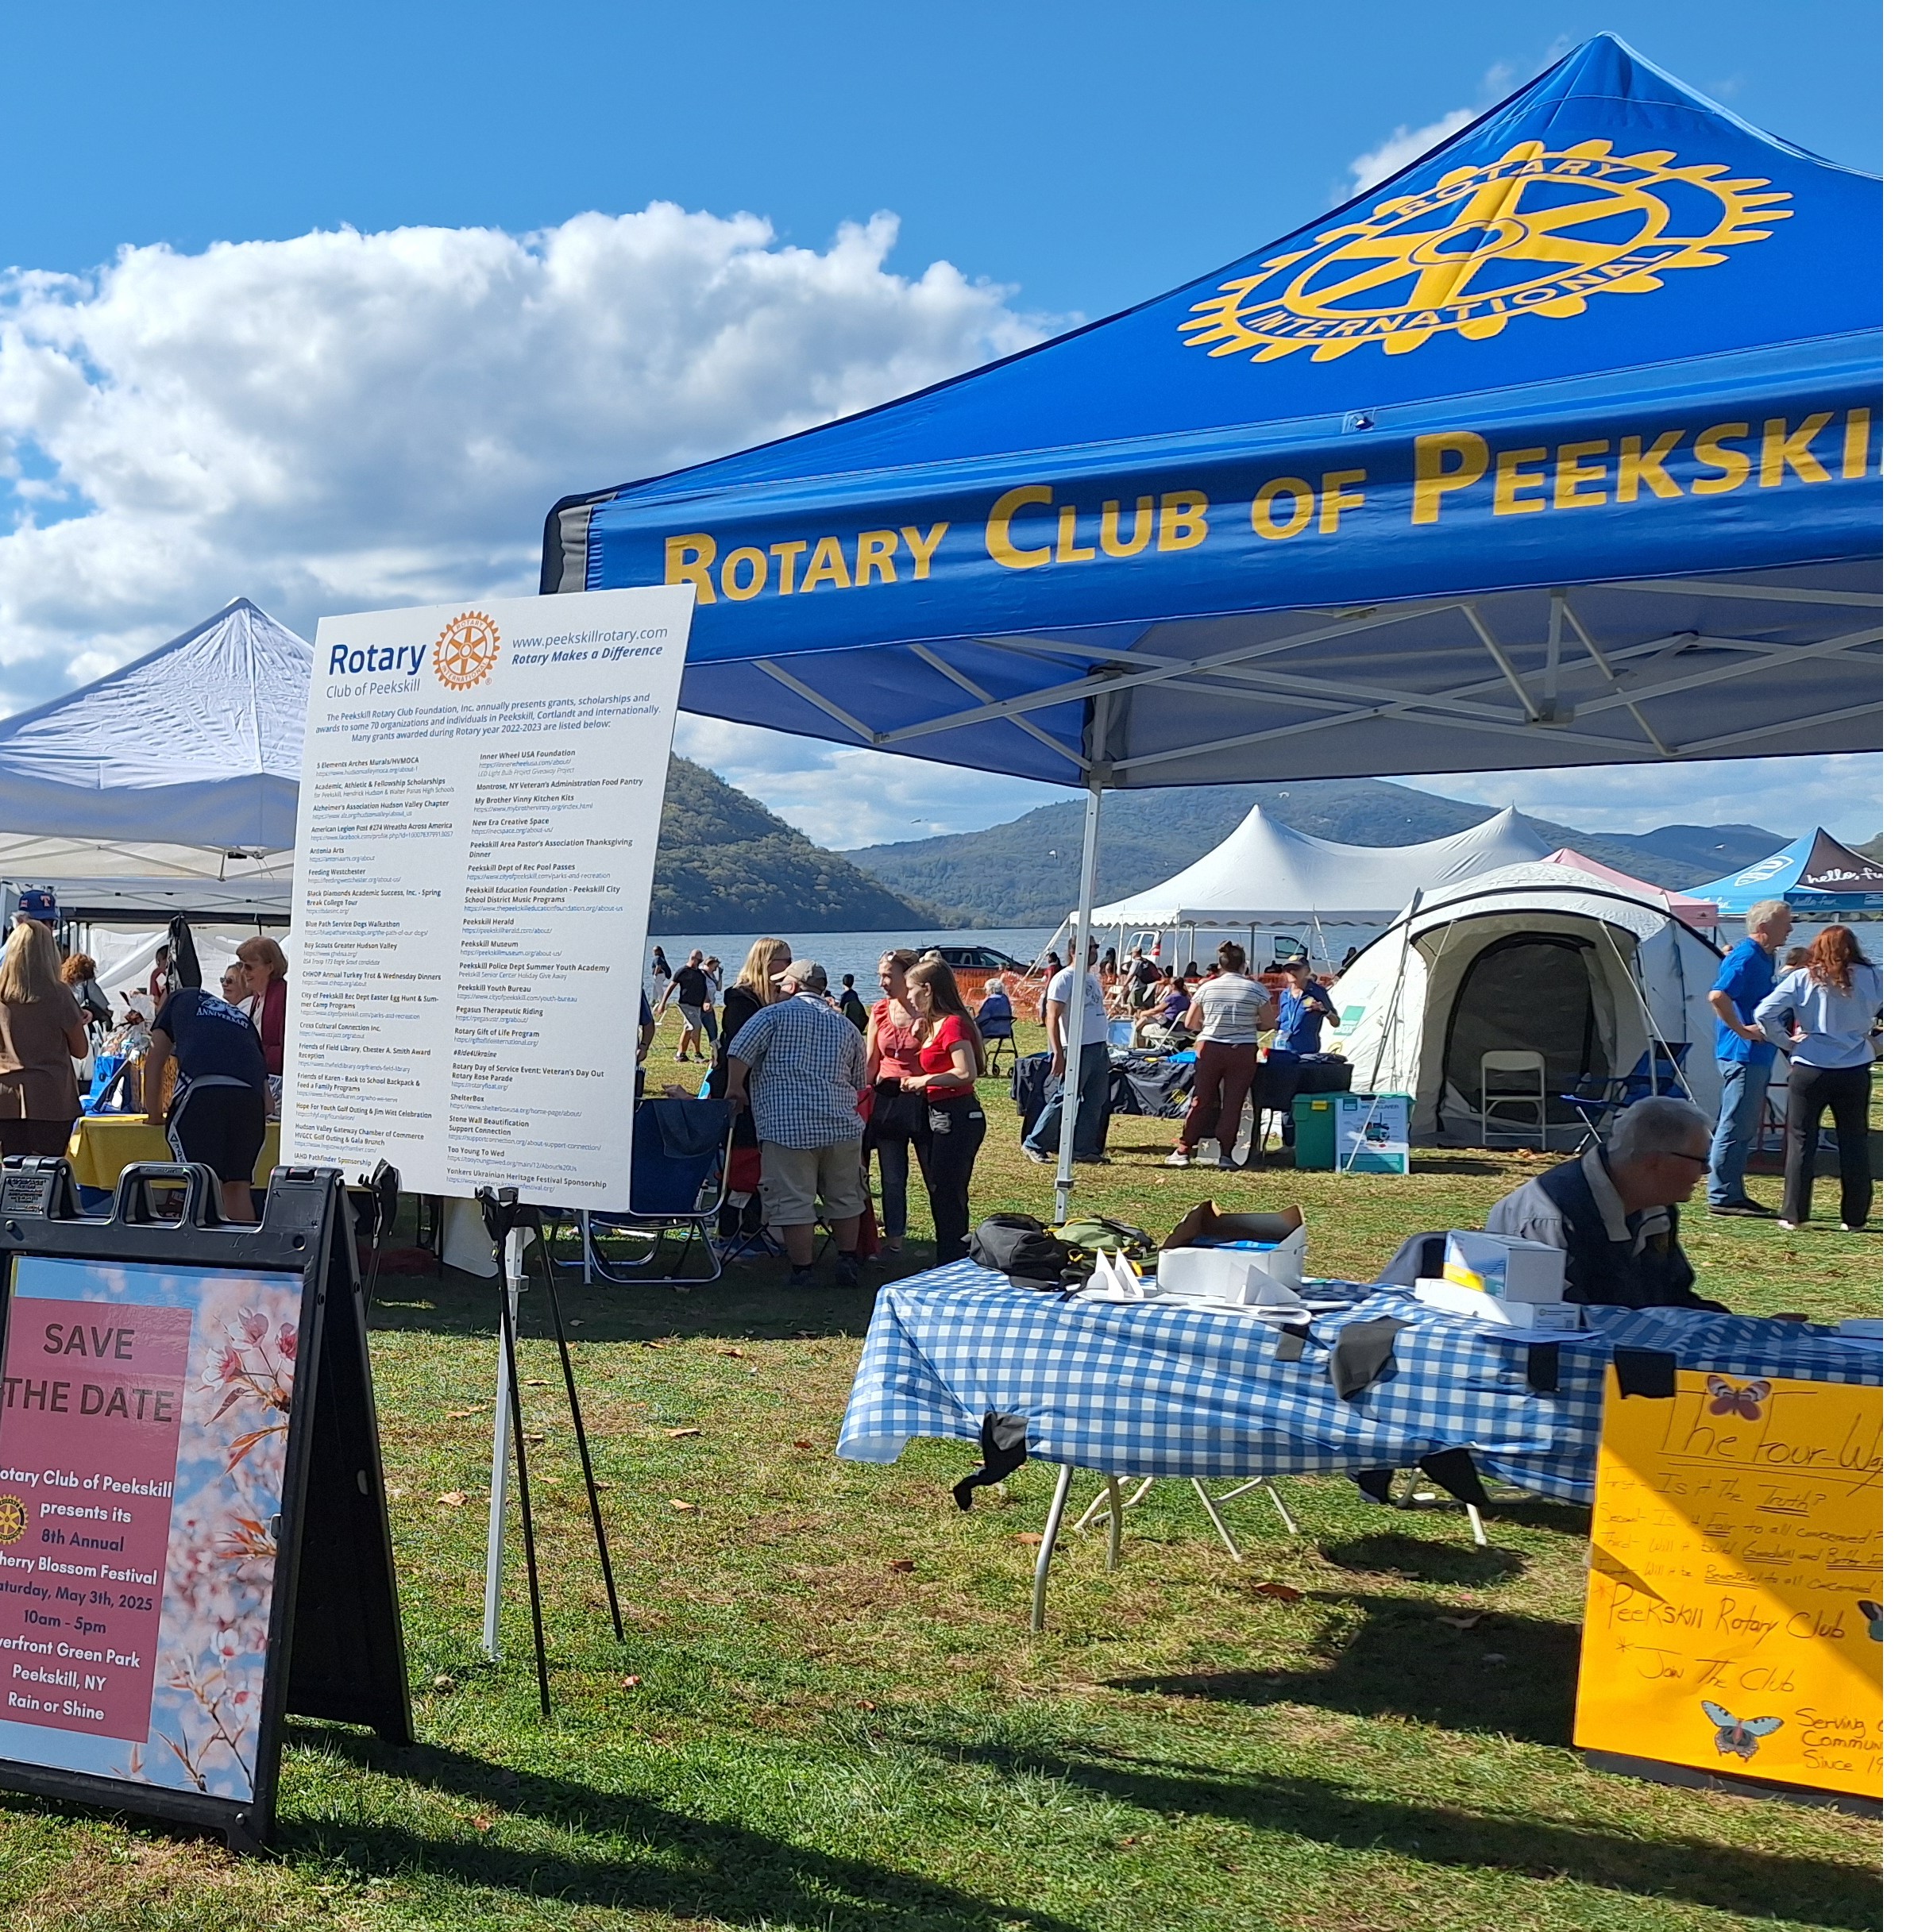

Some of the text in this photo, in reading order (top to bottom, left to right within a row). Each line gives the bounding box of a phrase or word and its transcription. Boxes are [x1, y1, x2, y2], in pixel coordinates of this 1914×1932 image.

[1396, 158, 1638, 216] ROTARY
[1246, 249, 1676, 337] INTERNATIONAL
[665, 407, 1883, 605] ROTARY CLUB OF PEEKSKI
[456, 619, 484, 631] ROTARY
[512, 628, 667, 649] www.peekskillrotary.com
[329, 644, 426, 675] Rotary
[511, 646, 662, 665] Rotary Makes a Difference
[442, 661, 488, 682] INTERNATIONAL
[326, 678, 420, 698] Club of Peekskill
[341, 710, 370, 719] Peekskill
[372, 710, 396, 719] Rotary
[396, 708, 413, 716] Club
[476, 701, 510, 711] annually
[511, 700, 546, 711] presents
[577, 694, 631, 705] scholarships
[632, 692, 650, 702] and
[315, 724, 340, 733] awards
[380, 719, 429, 731] organizations
[446, 715, 487, 724] individuals
[537, 710, 576, 719] Cortlandt
[351, 734, 371, 742] Many
[372, 733, 395, 742] grants
[396, 729, 428, 738] awarded
[429, 728, 453, 738] during
[455, 727, 481, 736] Rotary
[481, 727, 500, 736] year
[501, 723, 542, 733] 2022-2023
[558, 720, 581, 730] listed
[529, 817, 549, 826] Space
[1860, 867, 1883, 880] fu
[509, 962, 524, 971] Dept
[577, 964, 610, 973] Academy
[195, 1006, 249, 1030] ANNIVERSARY
[43, 1323, 135, 1359] SAVE
[3, 1377, 174, 1422] THE DATE
[0, 1467, 172, 1498] otary Club of Peekskill
[40, 1502, 131, 1522] presents its
[41, 1529, 124, 1552] 8th Annual
[0, 1551, 156, 1585] herry Blossom Festival
[0, 1580, 152, 1610] aturday, May 3th, 2025
[24, 1609, 60, 1627] 10am
[73, 1616, 106, 1634] 5pm
[1786, 1610, 1845, 1639] Club
[56, 1642, 102, 1661] Green
[106, 1649, 140, 1668] Park
[12, 1664, 106, 1691] Peekskill, NY
[8, 1691, 104, 1720] Rain or Shine
